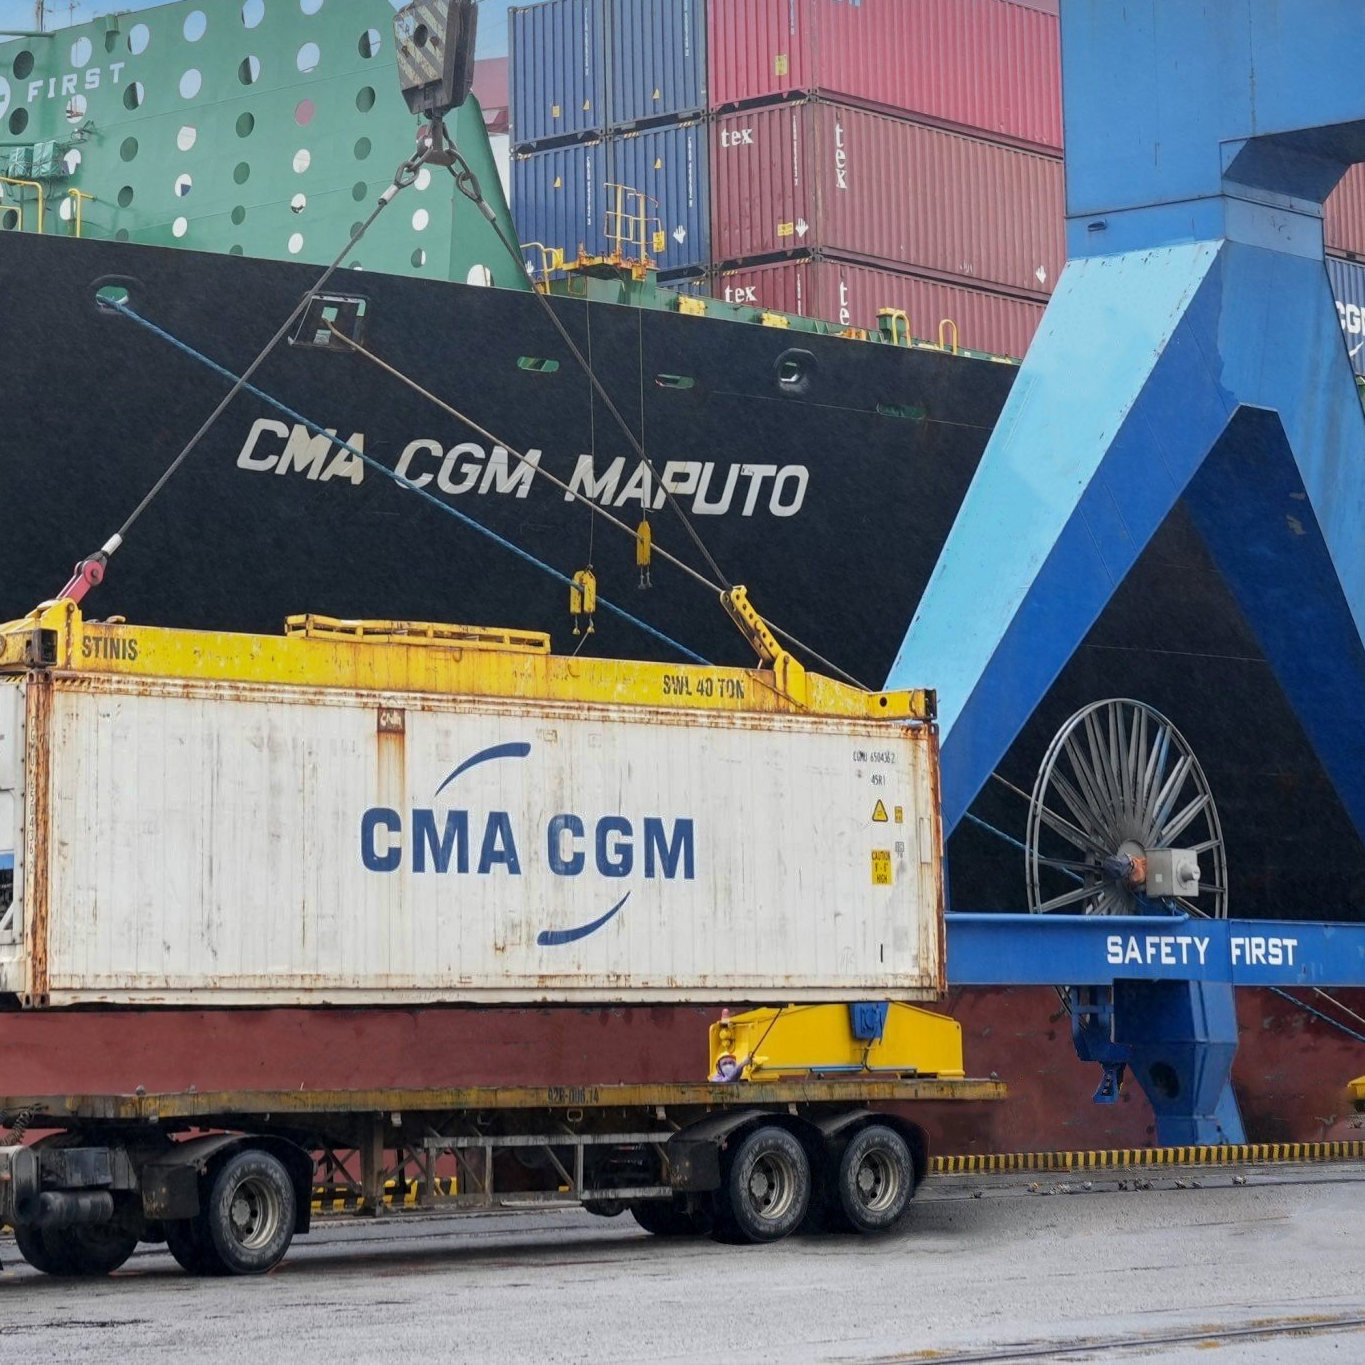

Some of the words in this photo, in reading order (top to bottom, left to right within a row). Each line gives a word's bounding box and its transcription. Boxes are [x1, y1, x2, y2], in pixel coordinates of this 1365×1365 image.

[27, 62, 125, 103] FIRST
[721, 128, 755, 148] tex
[835, 123, 848, 189] tex
[724, 285, 757, 303] tex
[236, 418, 365, 486] CMA
[394, 439, 543, 499] CGM
[564, 454, 810, 517] MAPUTO
[82, 636, 139, 661] STINIS
[663, 674, 693, 696] SWL
[696, 678, 714, 697] 40
[718, 678, 745, 699] TON
[361, 807, 522, 875] CMA
[547, 814, 695, 880] CGM
[1107, 935, 1209, 965] SAFETY
[1231, 936, 1298, 966] FIRST
